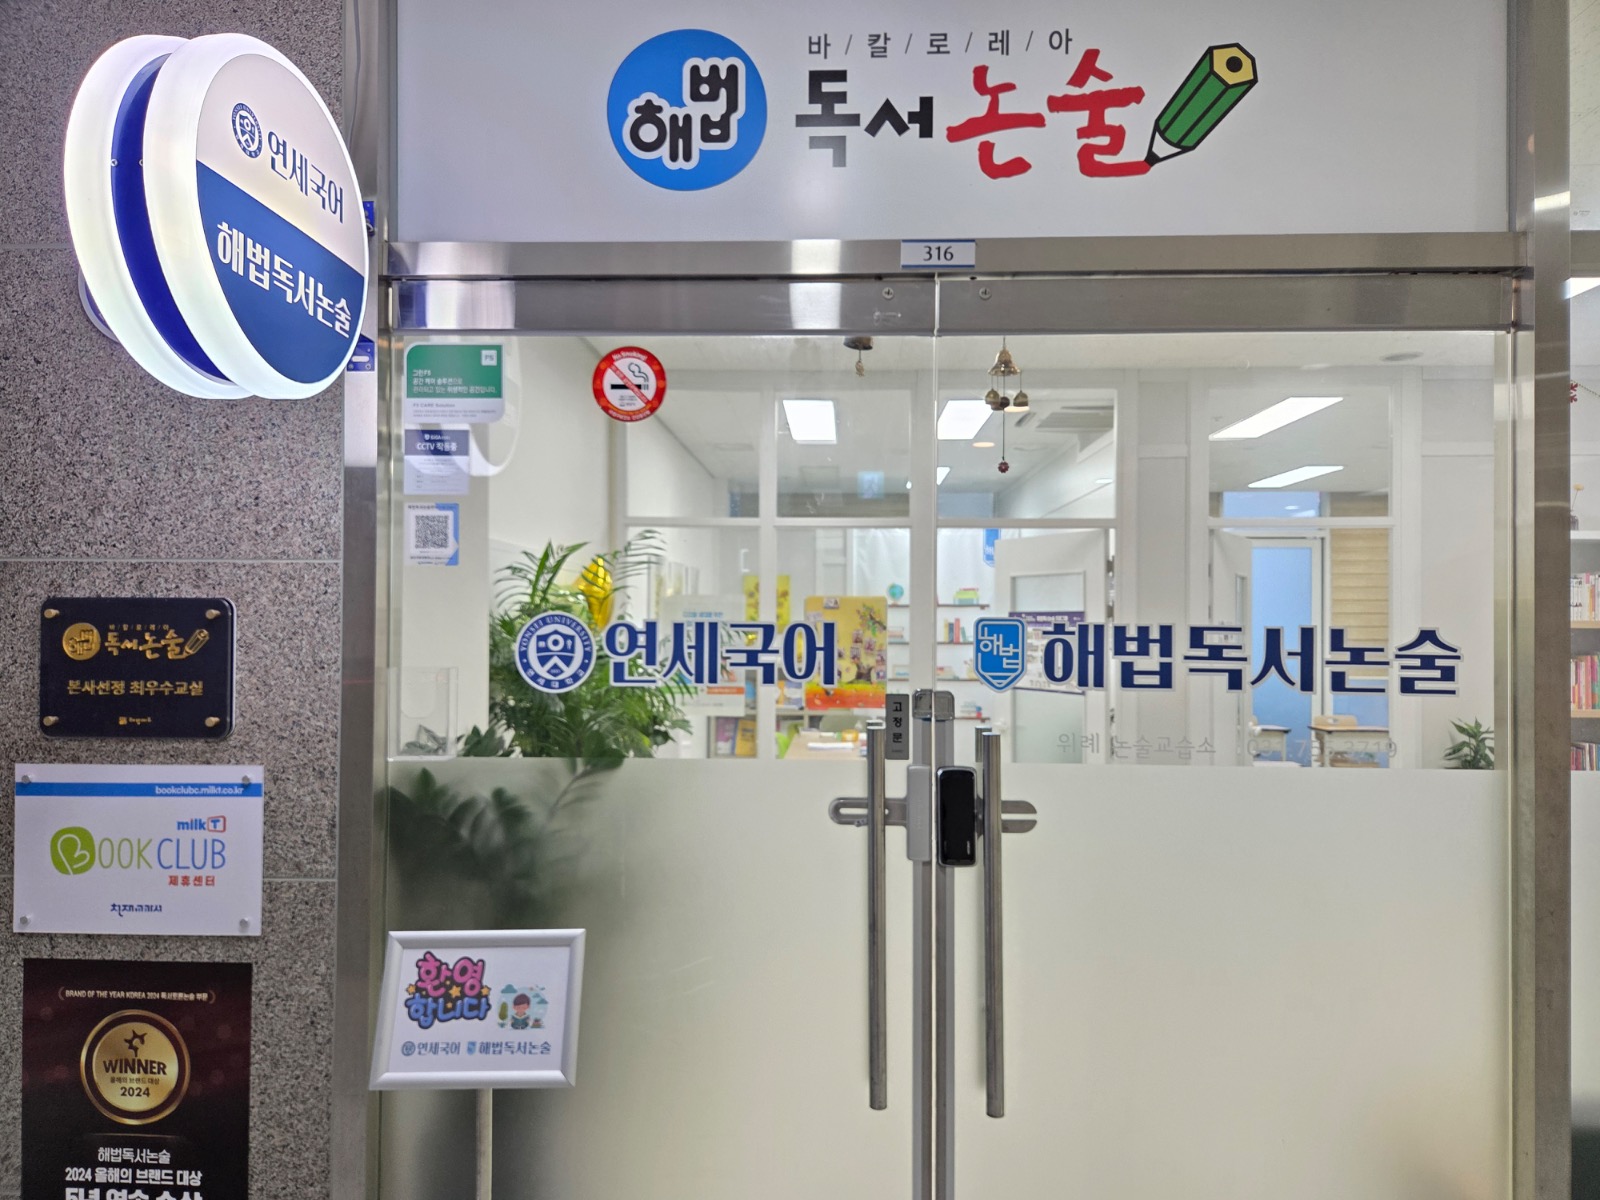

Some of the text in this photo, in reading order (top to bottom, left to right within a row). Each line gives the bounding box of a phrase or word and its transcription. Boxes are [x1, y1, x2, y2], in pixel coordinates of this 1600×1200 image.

[628, 61, 740, 166] 해법
[267, 130, 344, 225] 연세국어
[923, 245, 954, 262] 316
[217, 220, 352, 339] 해법독서논술
[417, 442, 435, 450] CCTV
[520, 616, 592, 652] YONSEI UNIVERSITY
[604, 621, 837, 686] 연세국어
[1042, 624, 1461, 696] 해법독서논술
[67, 680, 204, 696] 본사선정 최우수교실
[892, 702, 903, 744] 고정문
[1057, 733, 1100, 754] 위례
[1113, 735, 1217, 760] 논술교습소
[157, 838, 226, 870] CLUB
[415, 951, 485, 998] 환영
[87, 990, 96, 998] OF
[108, 991, 125, 999] YEAR
[125, 991, 146, 999] KOREA
[405, 994, 491, 1029] 합니다
[417, 1041, 551, 1056] 연세국어 해법독서논술
[103, 1058, 168, 1076] WINNER
[120, 1087, 150, 1098] 2024
[129, 1077, 147, 1085] 브랜드
[148, 1077, 160, 1086] 대상
[97, 1147, 171, 1165] 해법독서논술
[65, 1167, 203, 1187] 2024 올해의 브랜드 대상
